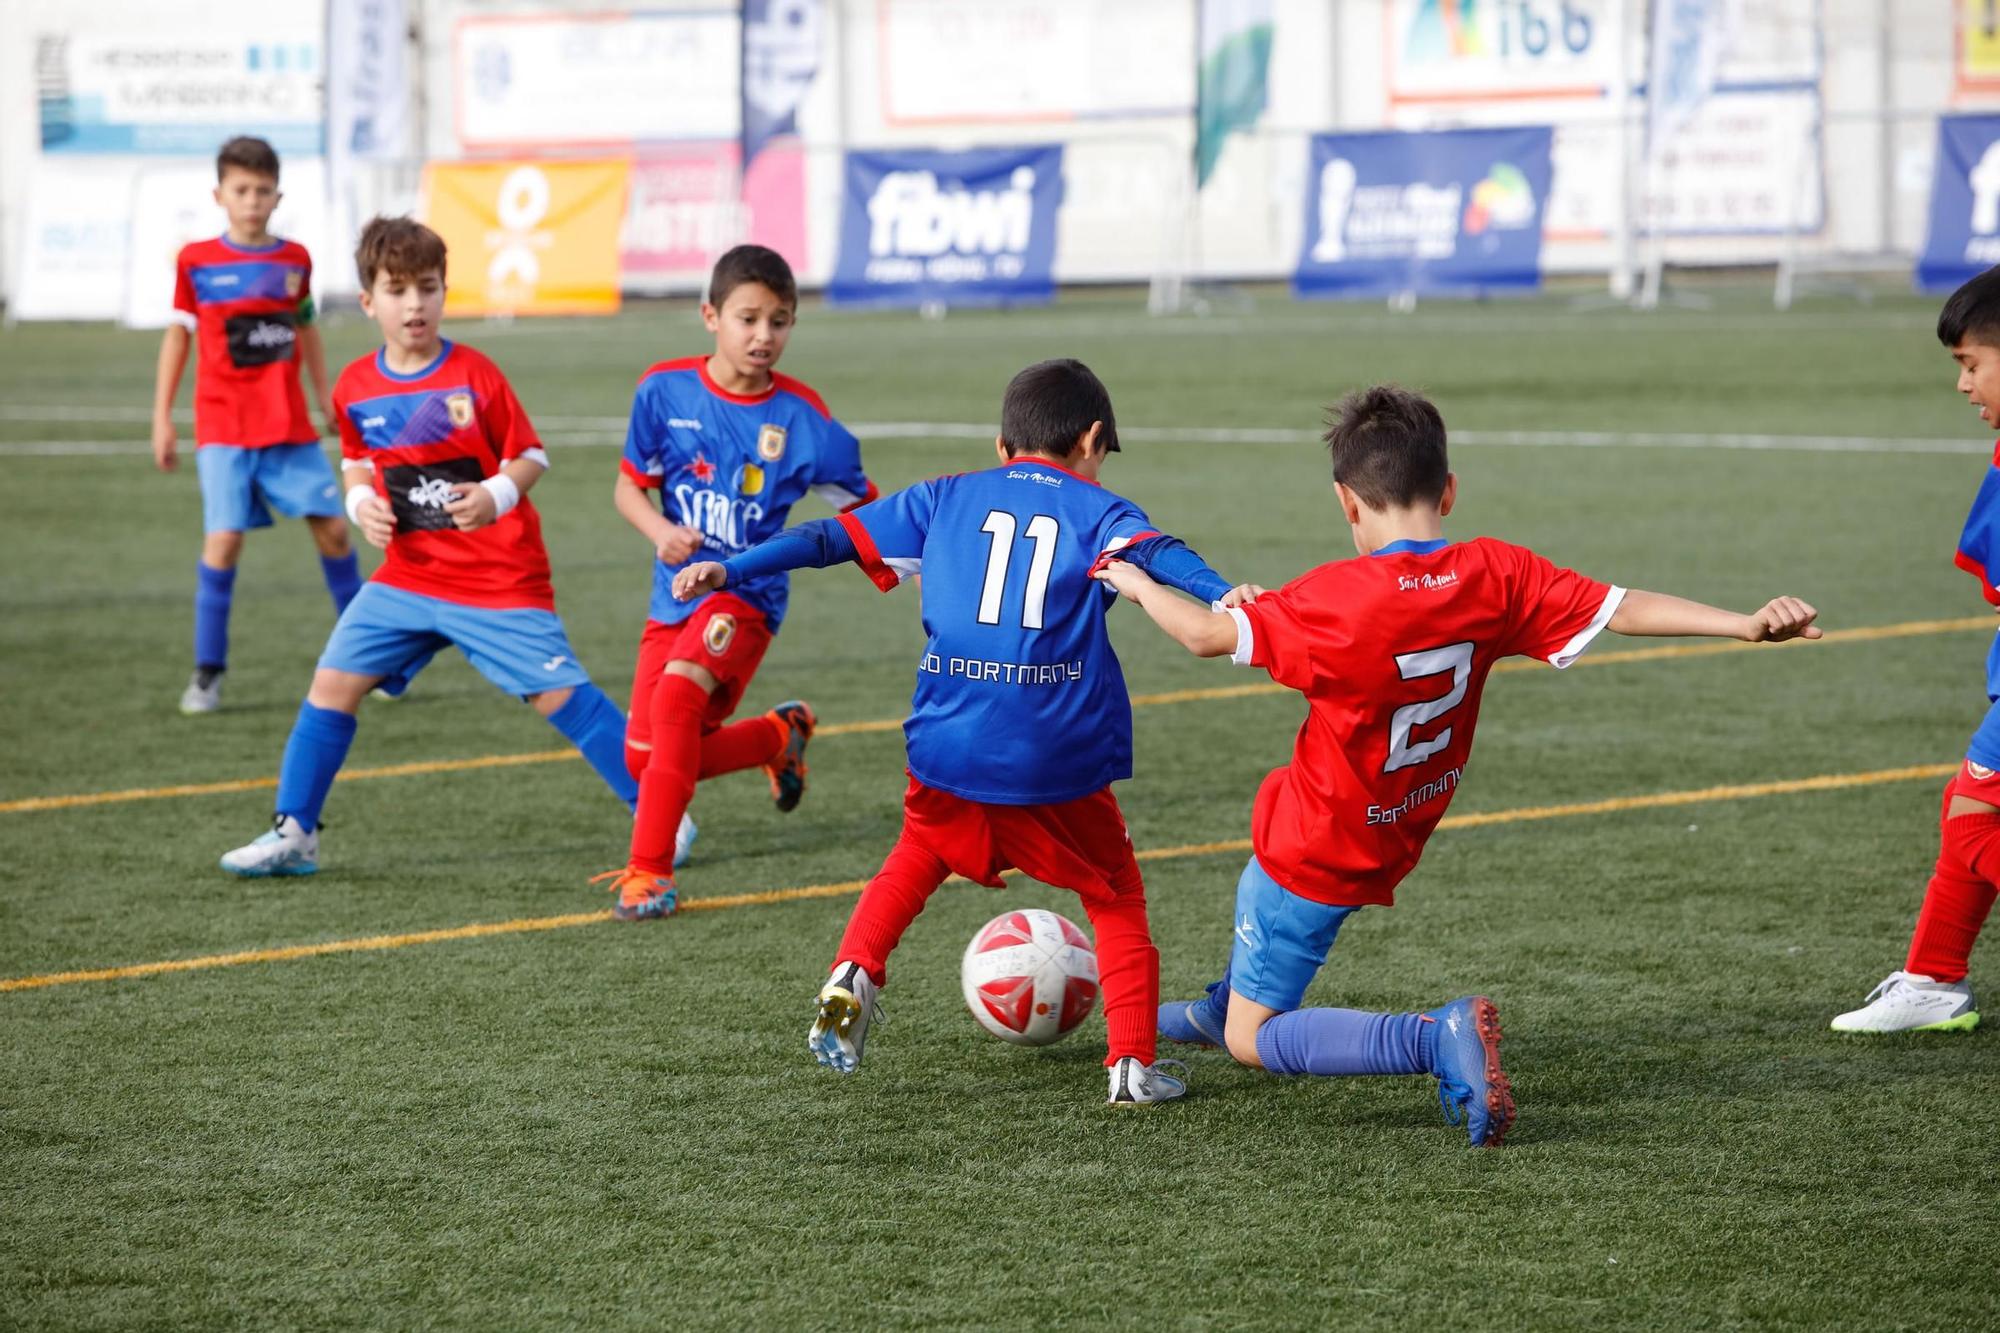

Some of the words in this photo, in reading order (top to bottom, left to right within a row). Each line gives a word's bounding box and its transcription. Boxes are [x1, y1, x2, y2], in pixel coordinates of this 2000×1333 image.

[977, 508, 1060, 630] 11
[950, 657, 1082, 685] PORTMANY
[1382, 640, 1475, 774] 2
